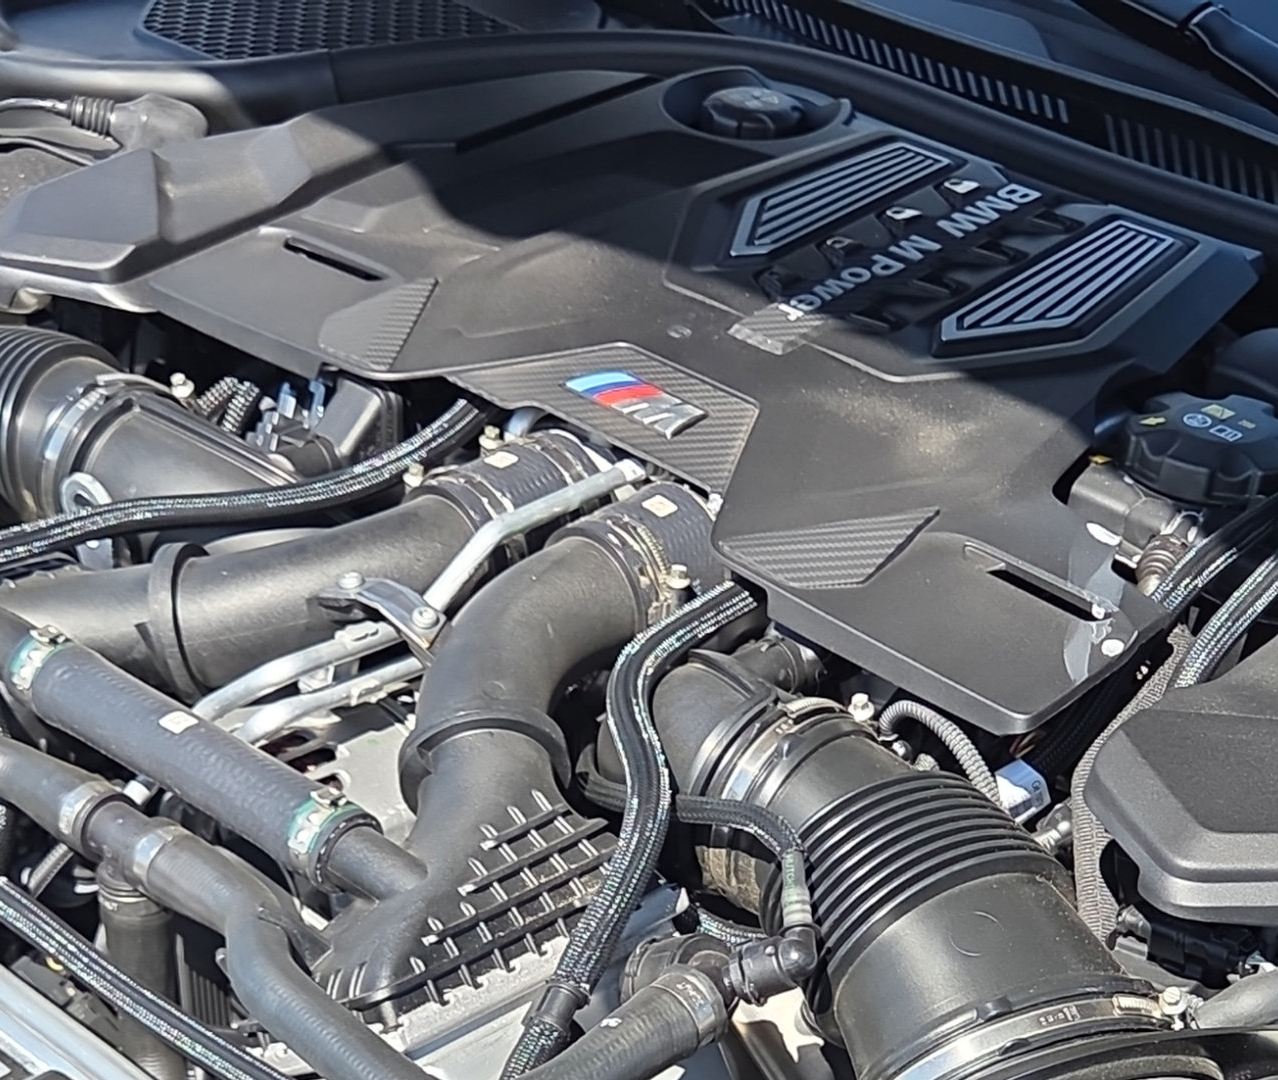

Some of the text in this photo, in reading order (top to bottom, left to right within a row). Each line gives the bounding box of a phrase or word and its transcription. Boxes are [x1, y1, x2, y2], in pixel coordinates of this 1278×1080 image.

[778, 183, 1042, 321] BMW M Power
